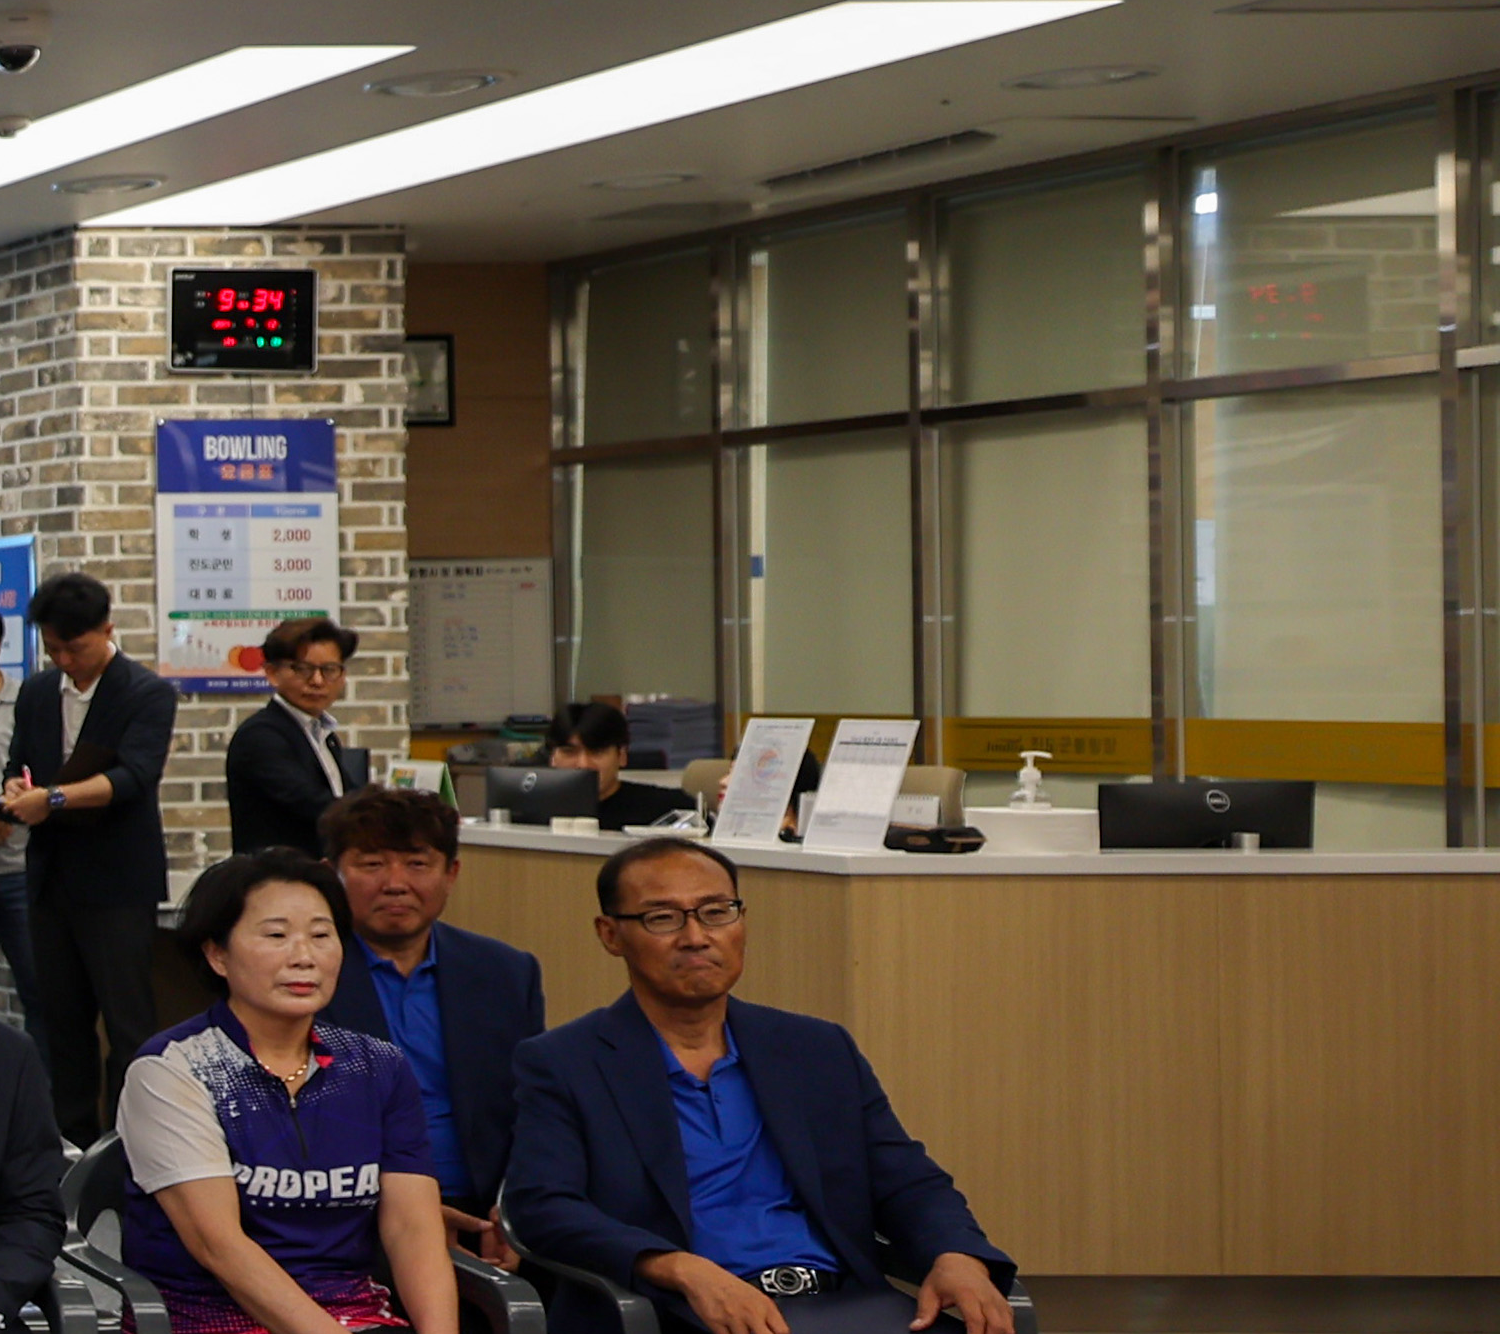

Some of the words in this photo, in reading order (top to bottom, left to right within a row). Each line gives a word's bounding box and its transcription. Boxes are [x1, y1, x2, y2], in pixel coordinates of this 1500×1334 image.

[252, 288, 285, 312] 34
[203, 435, 287, 461] BOWLING
[220, 464, 274, 480] 요금표
[273, 529, 312, 543] 2,000
[189, 558, 233, 571] 진도군민
[274, 558, 312, 573] 3,000
[276, 588, 313, 602] 1,000
